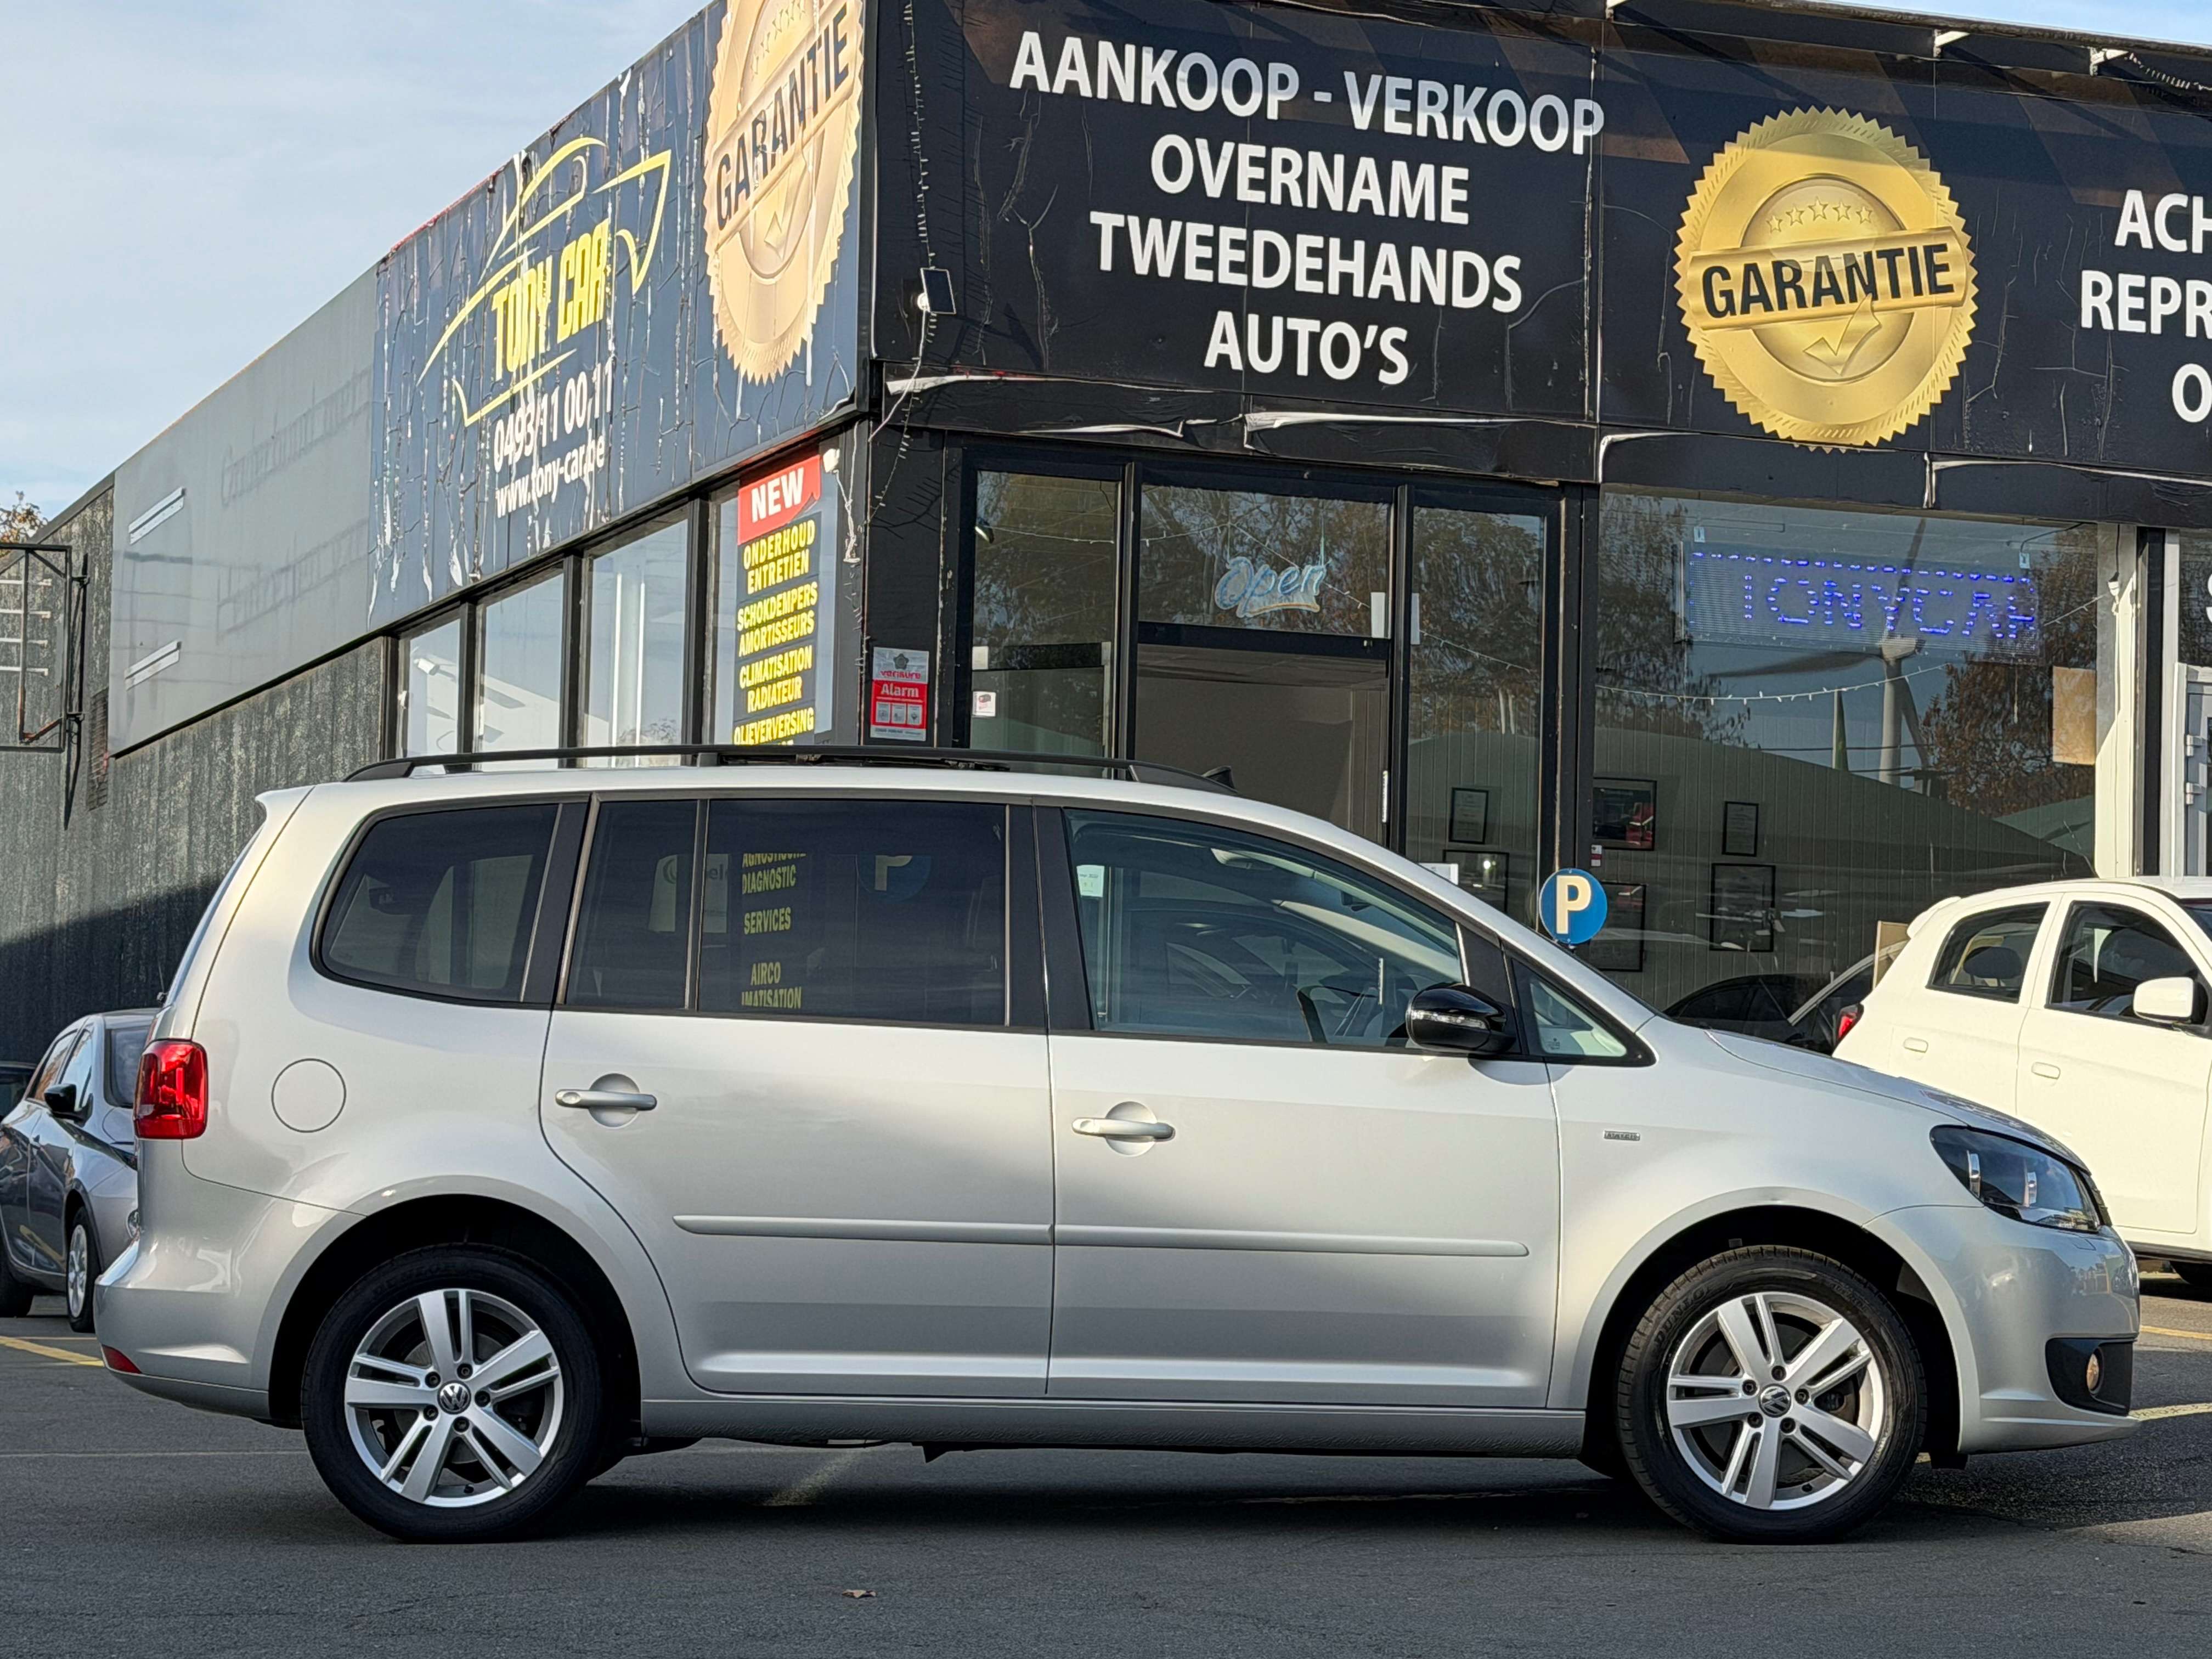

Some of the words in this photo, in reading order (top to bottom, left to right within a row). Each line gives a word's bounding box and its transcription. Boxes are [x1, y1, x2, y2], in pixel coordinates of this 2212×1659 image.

[716, 2, 849, 231] GARANTIE
[1009, 31, 1300, 120] AANKOOP
[1344, 71, 1604, 155] VERKOOP
[1151, 134, 1469, 225] OVERNAME
[557, 218, 609, 344] CAR
[1090, 211, 1522, 313] TWEEDEHANDS
[1701, 243, 1955, 318] GARANTIE
[1205, 310, 1409, 385] AUTO'S
[751, 467, 804, 523] NEW
[743, 520, 815, 570] ONDERHOUD
[747, 549, 809, 594] ENTRETIEN
[1215, 556, 1327, 618] Open
[737, 582, 818, 631] SCHOKDEMPERS
[738, 610, 815, 657] AMORTISSEURS
[740, 645, 812, 689] CLIMATISATION
[881, 683, 919, 698] Alarm
[747, 675, 803, 713] RADIATEUR
[733, 707, 814, 745] OLIEVERVERSING
[742, 864, 797, 895] DIAGNOSTIC
[1556, 875, 1592, 934] P
[744, 906, 791, 935] SERVICES
[750, 962, 781, 986] AIRCO
